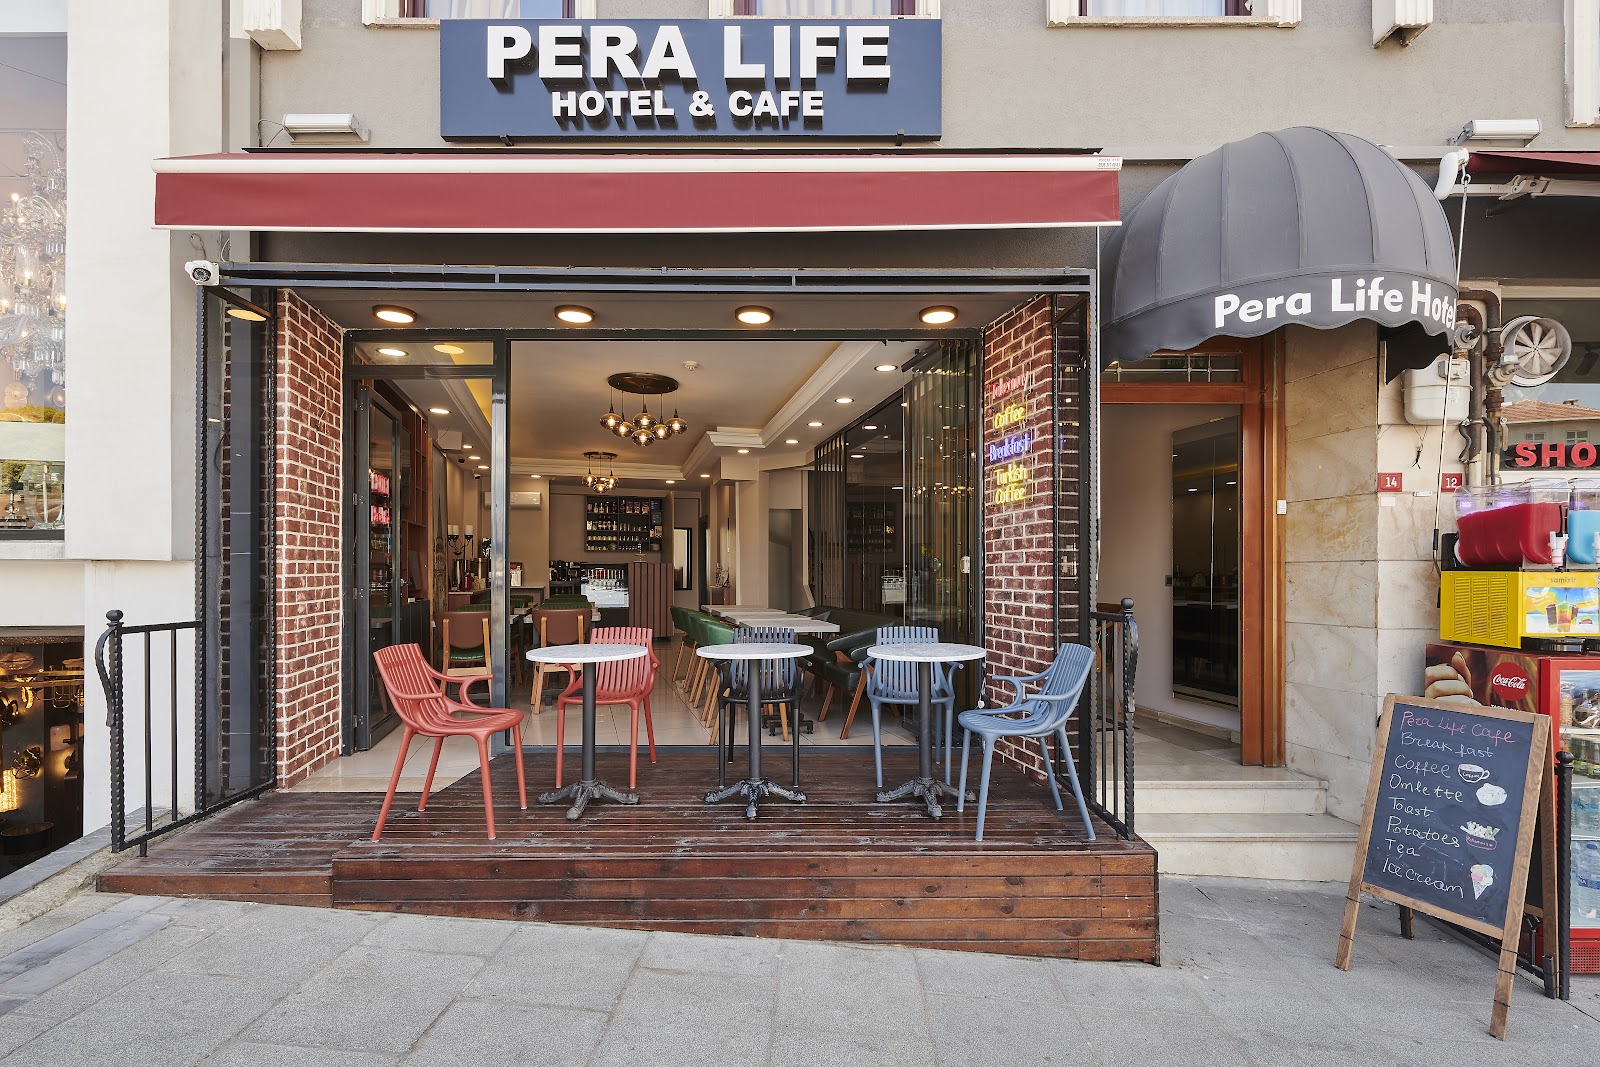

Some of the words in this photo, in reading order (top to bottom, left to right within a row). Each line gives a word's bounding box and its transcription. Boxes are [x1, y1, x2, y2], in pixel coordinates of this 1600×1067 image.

[486, 25, 698, 79] PERA
[723, 25, 891, 79] LIFE
[551, 90, 675, 117] HOTEL
[688, 90, 715, 118] &
[728, 90, 824, 117] CAFE
[1214, 292, 1312, 329] Pera
[1331, 276, 1404, 313] Life
[1410, 280, 1457, 331] Hotel
[994, 403, 1026, 430] Coffee
[989, 433, 1031, 463] Breakfast
[1514, 441, 1597, 467] SHO
[994, 463, 1028, 486] Turkish
[1385, 476, 1397, 488] 14
[1445, 477, 1458, 489] 12
[994, 483, 1027, 505] Coffee
[1492, 673, 1528, 690] Coca-Cola
[1400, 710, 1435, 731] Pera
[1438, 718, 1467, 736] Life
[1471, 723, 1516, 747] Cafe
[1394, 754, 1452, 778] Coffee
[1388, 796, 1435, 818] Toast
[1386, 815, 1461, 848] Potatoes
[1384, 838, 1421, 857] Tea
[1382, 857, 1403, 878] Ice
